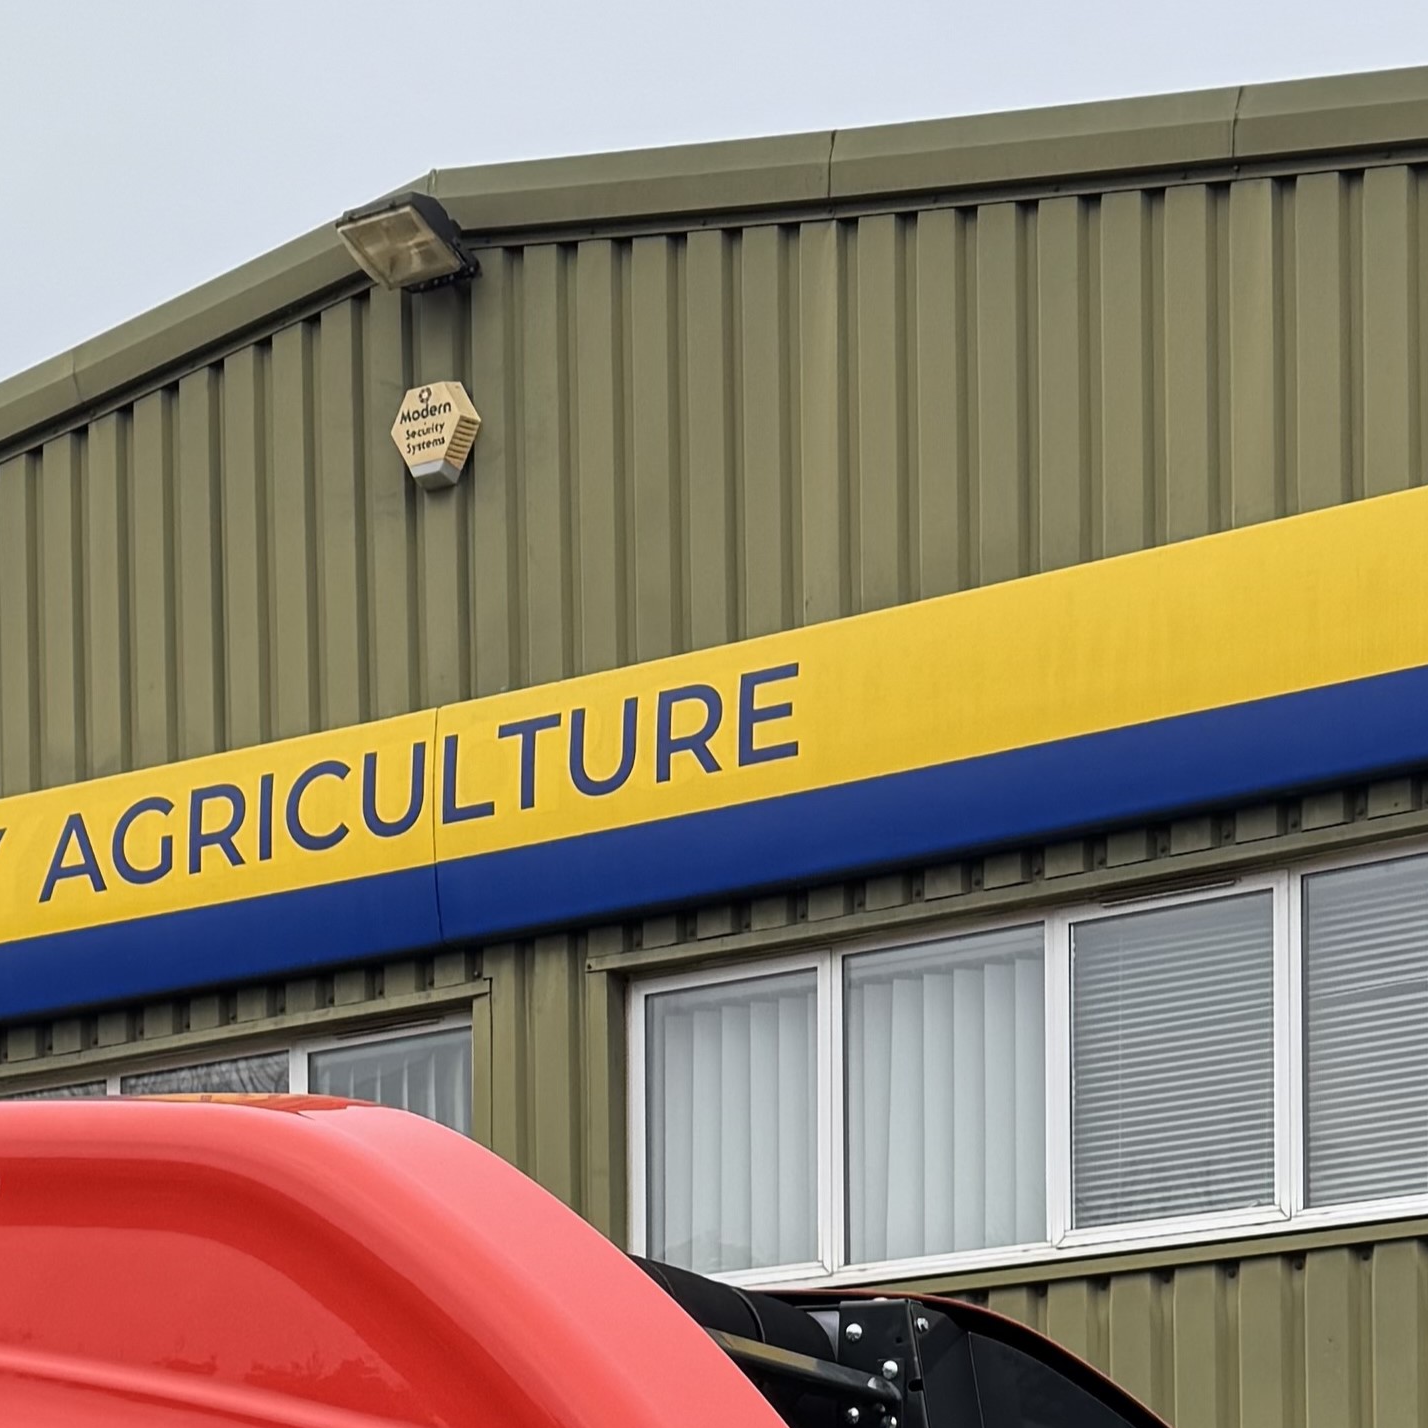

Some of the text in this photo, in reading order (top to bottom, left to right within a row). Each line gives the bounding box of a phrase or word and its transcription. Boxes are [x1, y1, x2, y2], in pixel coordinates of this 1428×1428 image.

[400, 401, 452, 424] Modern
[405, 421, 445, 441] Security
[406, 436, 445, 455] Systems
[37, 661, 800, 904] AGRICULTURE
